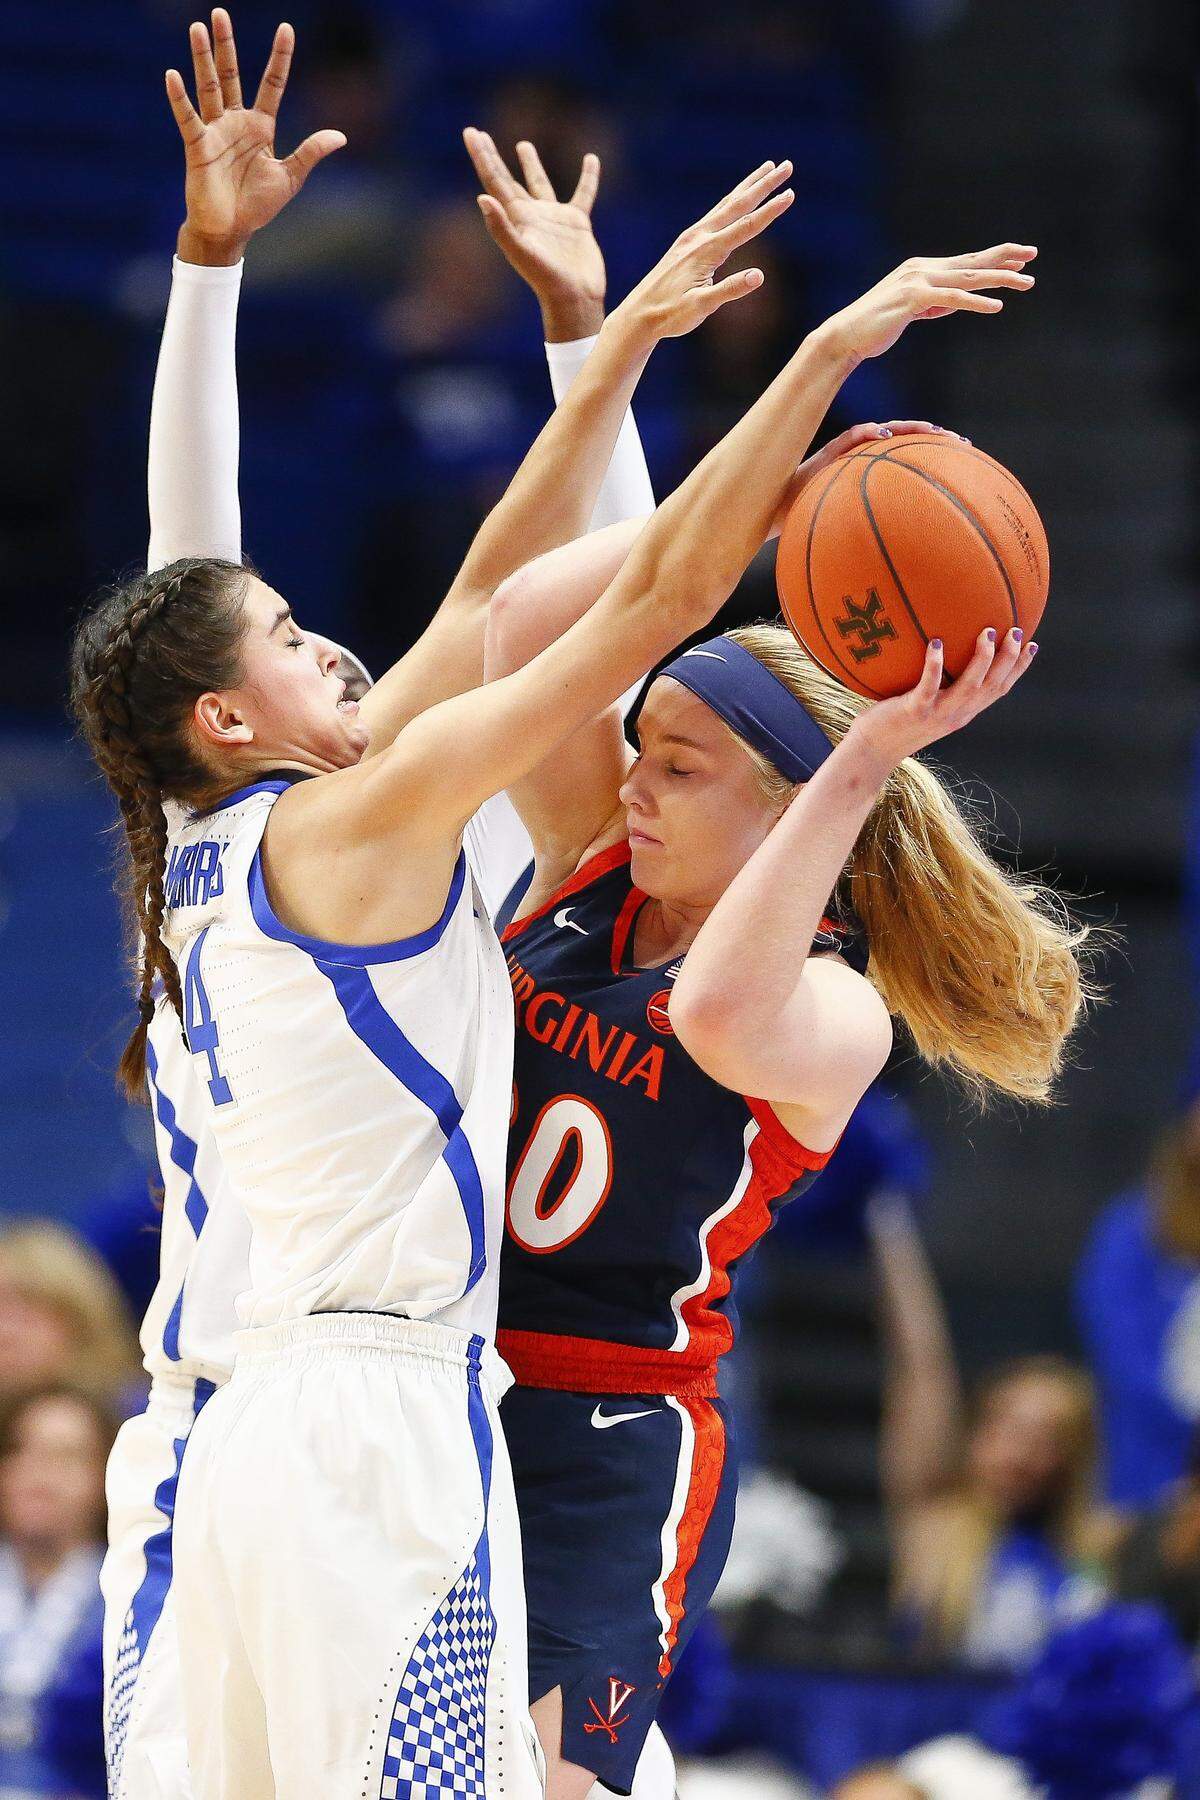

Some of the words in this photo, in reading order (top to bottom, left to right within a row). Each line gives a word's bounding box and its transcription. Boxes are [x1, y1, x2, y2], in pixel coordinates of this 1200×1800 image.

[185, 926, 234, 1107] 4
[507, 953, 665, 1101] RGINIA
[507, 1082, 614, 1254] 0
